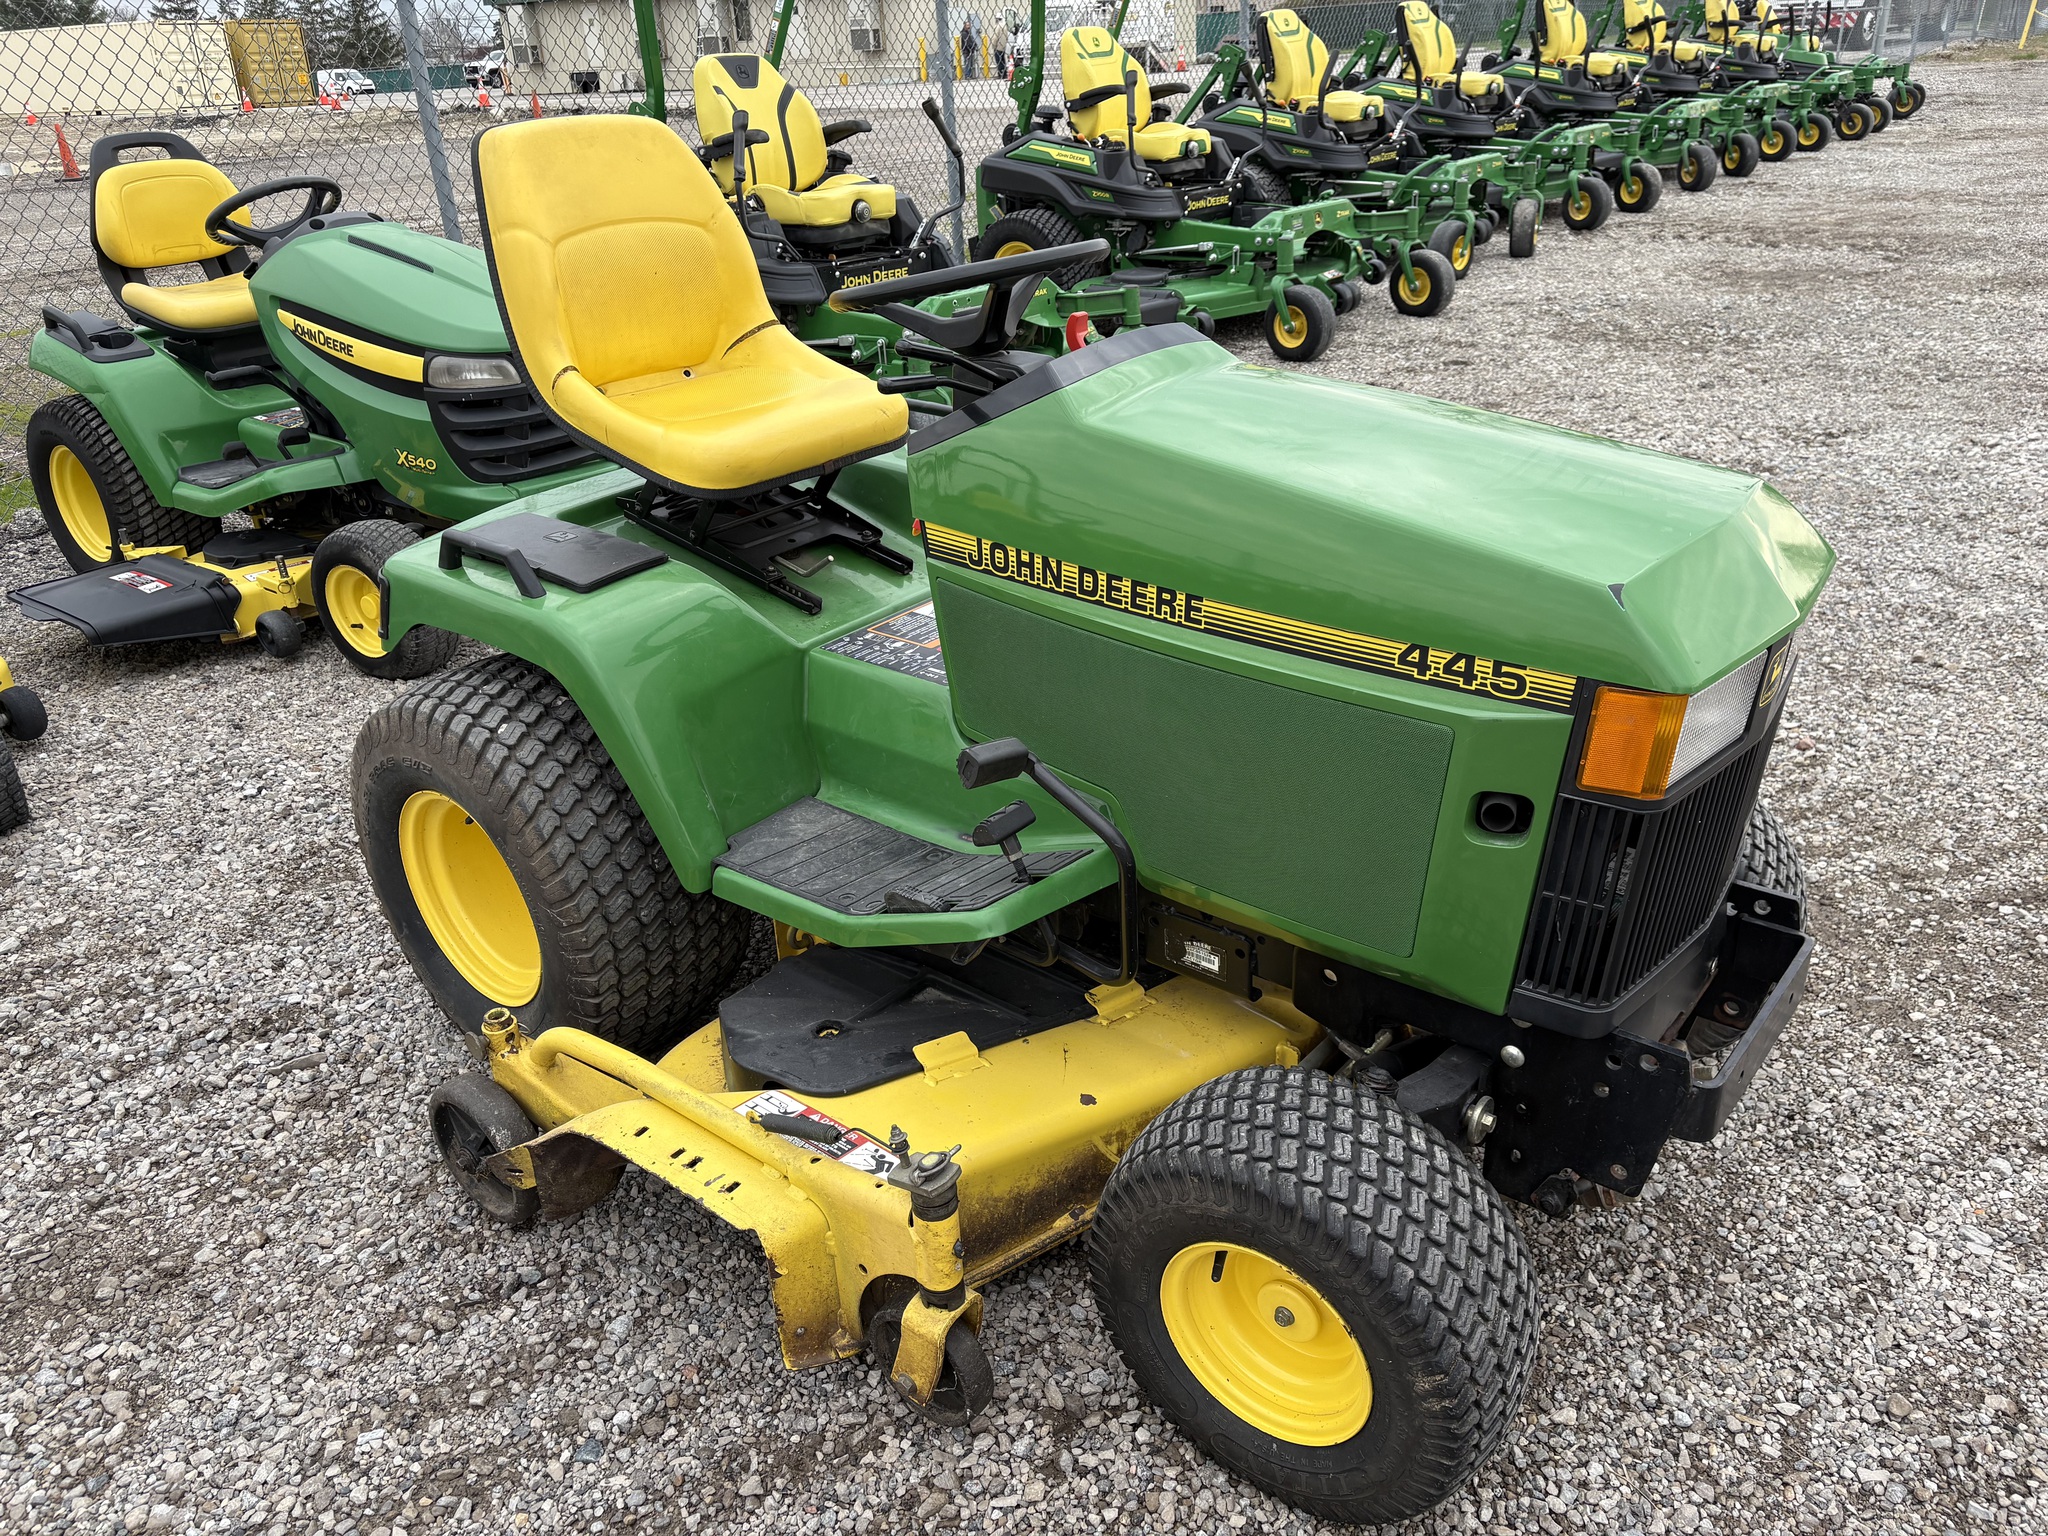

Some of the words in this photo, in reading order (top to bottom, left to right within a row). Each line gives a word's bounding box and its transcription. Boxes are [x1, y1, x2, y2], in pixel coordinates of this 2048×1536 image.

[1069, 153, 1086, 162] DEERE
[1187, 198, 1206, 211] JOHN
[1206, 195, 1229, 207] DEERE
[841, 272, 872, 289] JOHN
[873, 267, 909, 284] DEERE
[292, 318, 318, 342] JOHN
[317, 329, 355, 358] DEERE
[395, 447, 437, 471] X540
[967, 536, 1064, 592] JOHN
[1076, 563, 1205, 629] DEERE
[1395, 642, 1531, 700] 445
